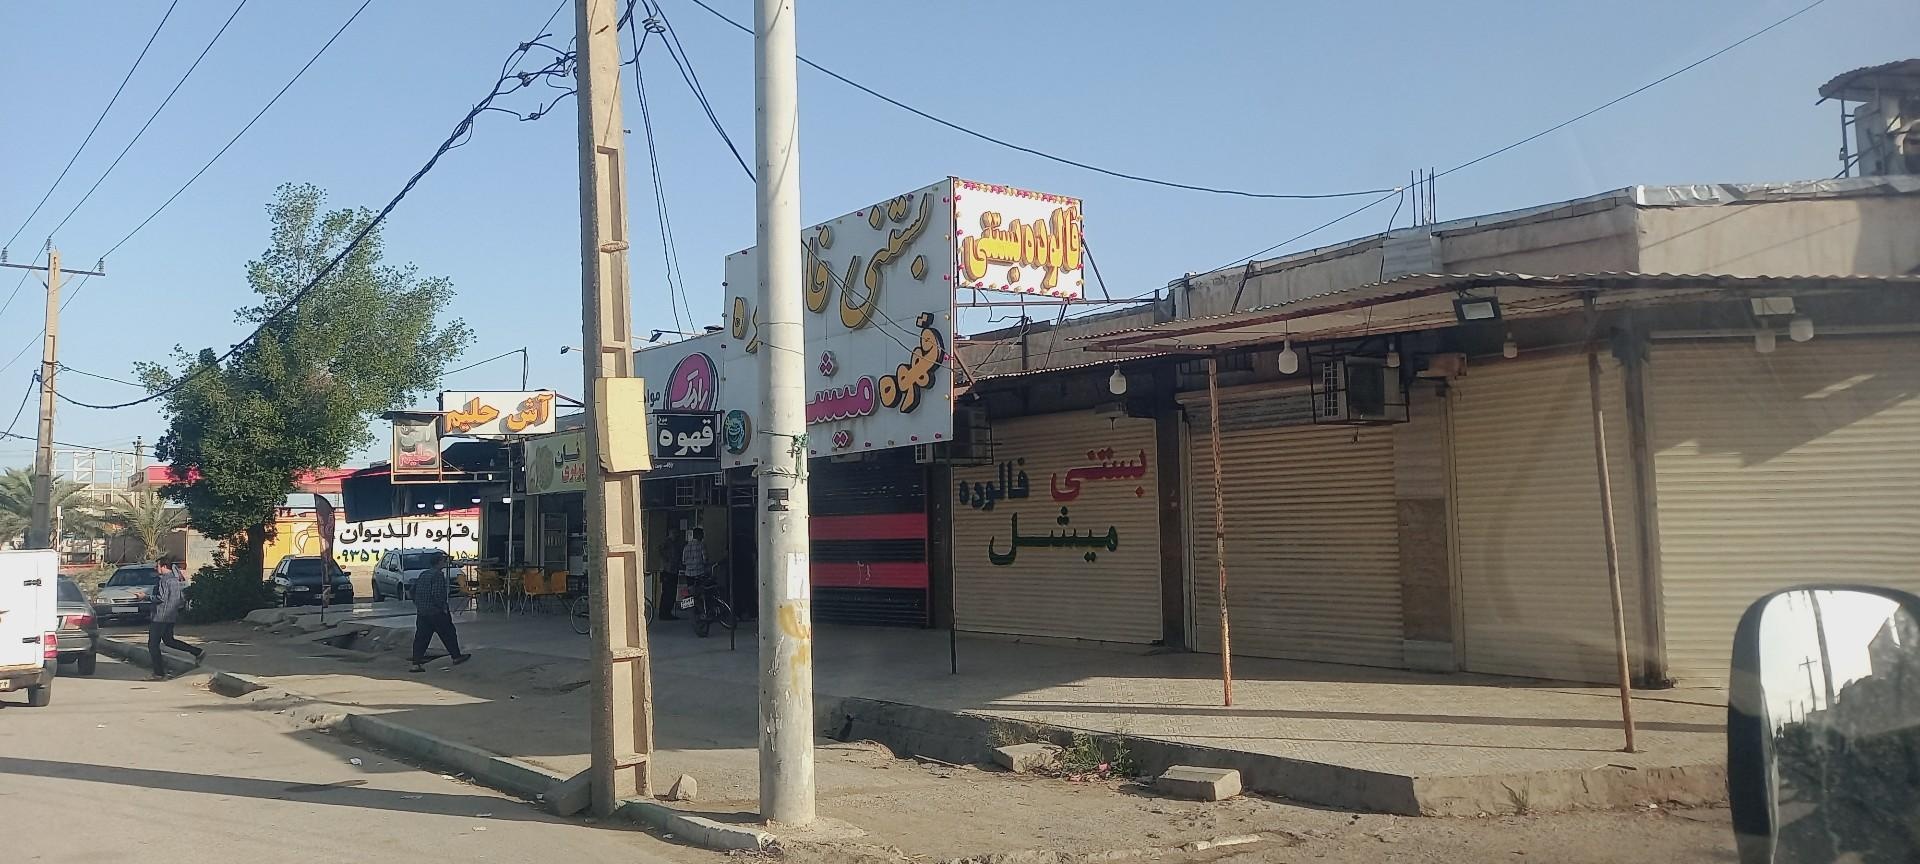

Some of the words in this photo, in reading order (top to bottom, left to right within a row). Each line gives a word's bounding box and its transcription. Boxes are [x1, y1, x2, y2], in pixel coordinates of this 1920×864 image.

[840, 191, 933, 329] بستنی
[962, 211, 1021, 283] بستنی
[1021, 206, 1081, 291] فالوده
[879, 312, 943, 413] قهوه
[444, 396, 500, 433] حلیم
[506, 394, 554, 432] آش
[806, 350, 876, 448] میش
[659, 419, 714, 456] قهوه
[958, 457, 1030, 511] فالوده
[1050, 447, 1147, 502] بستنی
[340, 522, 419, 544] الدیوان
[426, 522, 470, 542] قهوه
[988, 506, 1119, 565] میشل
